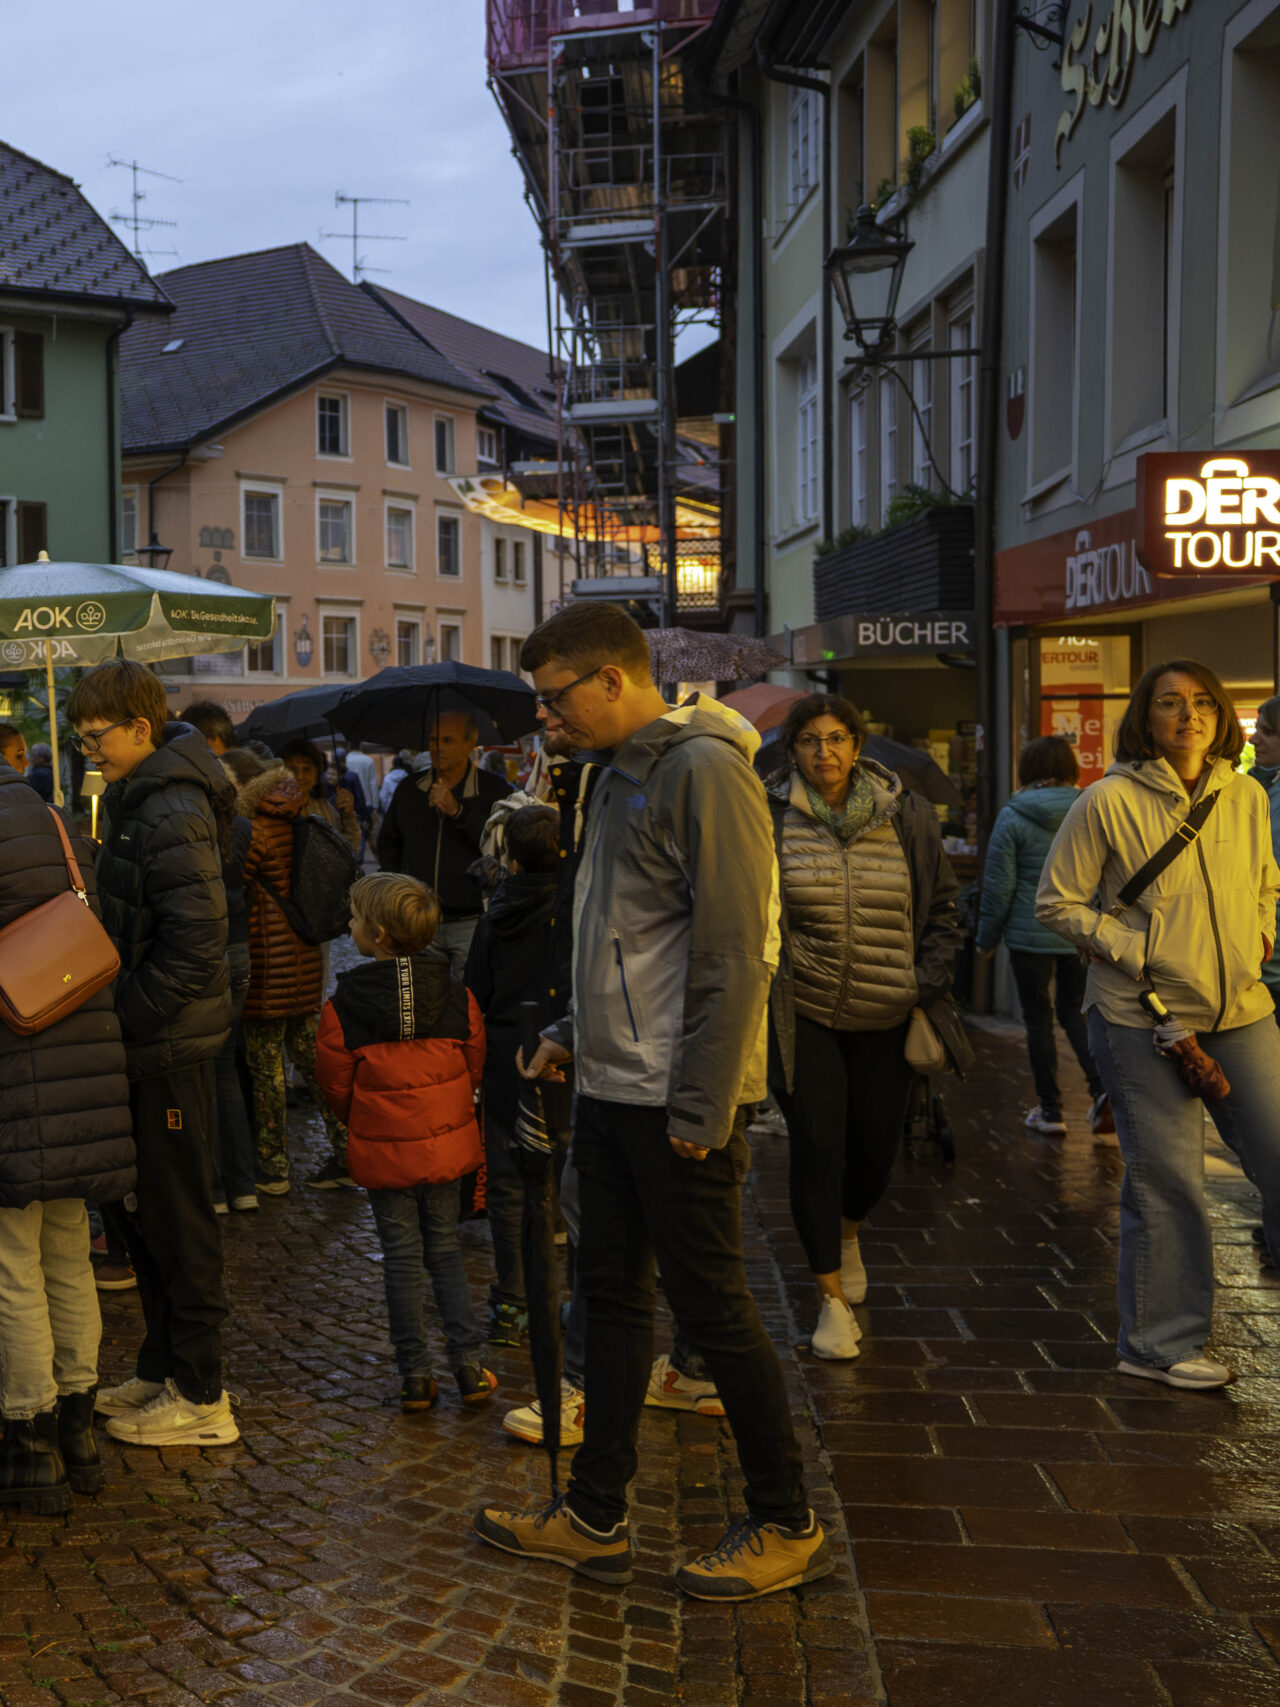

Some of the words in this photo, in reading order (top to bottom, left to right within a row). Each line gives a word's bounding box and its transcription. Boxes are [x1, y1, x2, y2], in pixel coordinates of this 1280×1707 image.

[1165, 472, 1280, 525] DER
[1164, 530, 1280, 569] TOUR
[13, 606, 73, 632] AOK
[858, 617, 969, 645] BÜCHER
[1041, 651, 1099, 664] ERTOUR
